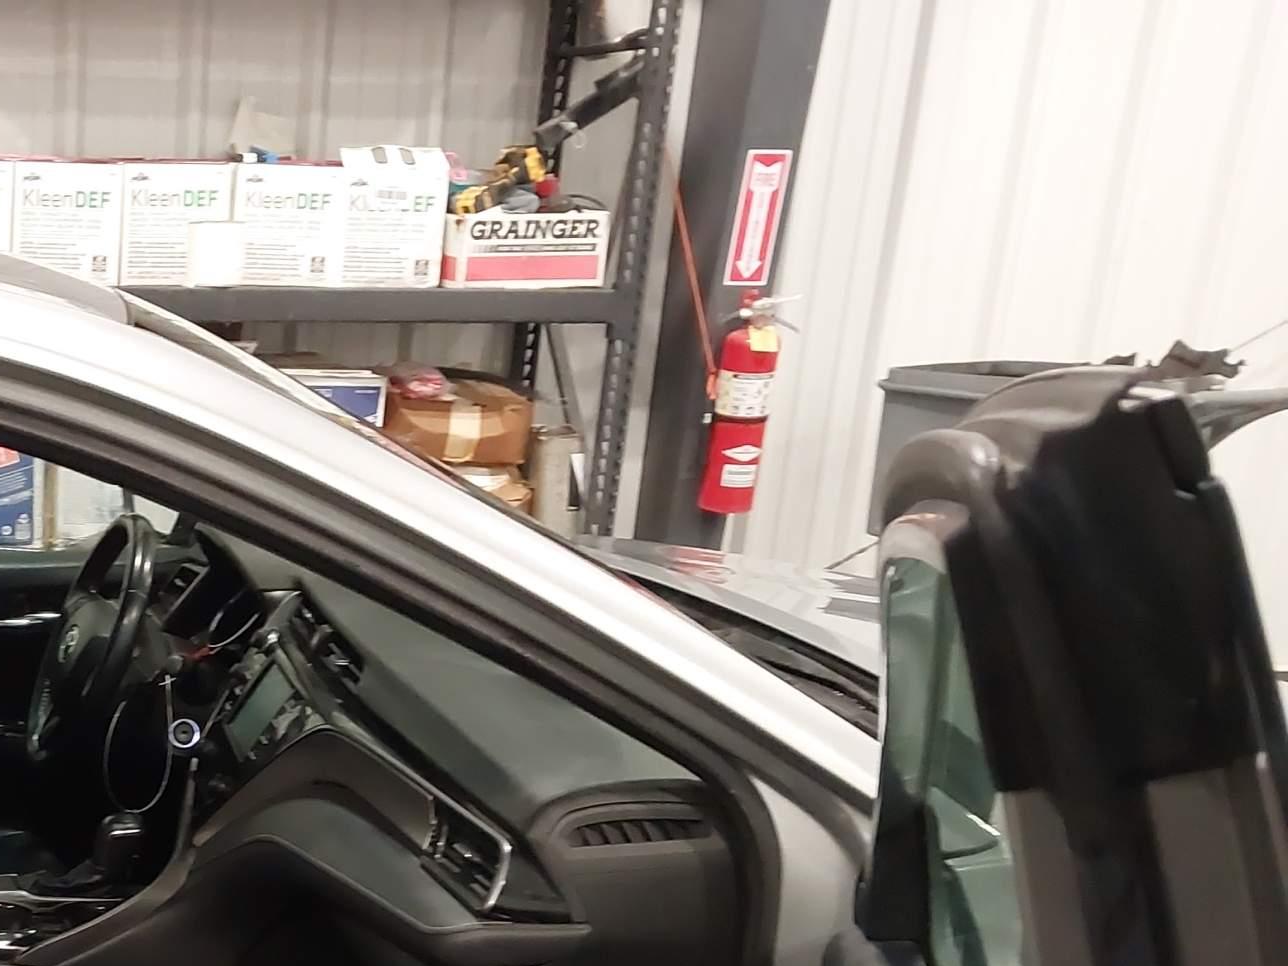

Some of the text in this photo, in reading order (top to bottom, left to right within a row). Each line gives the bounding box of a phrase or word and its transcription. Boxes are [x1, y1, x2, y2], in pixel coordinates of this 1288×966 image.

[23, 188, 112, 209] KleenDEF
[130, 188, 220, 208] KleenDEF
[245, 191, 333, 211] KleenDEF
[471, 218, 600, 241] GRAINGER
